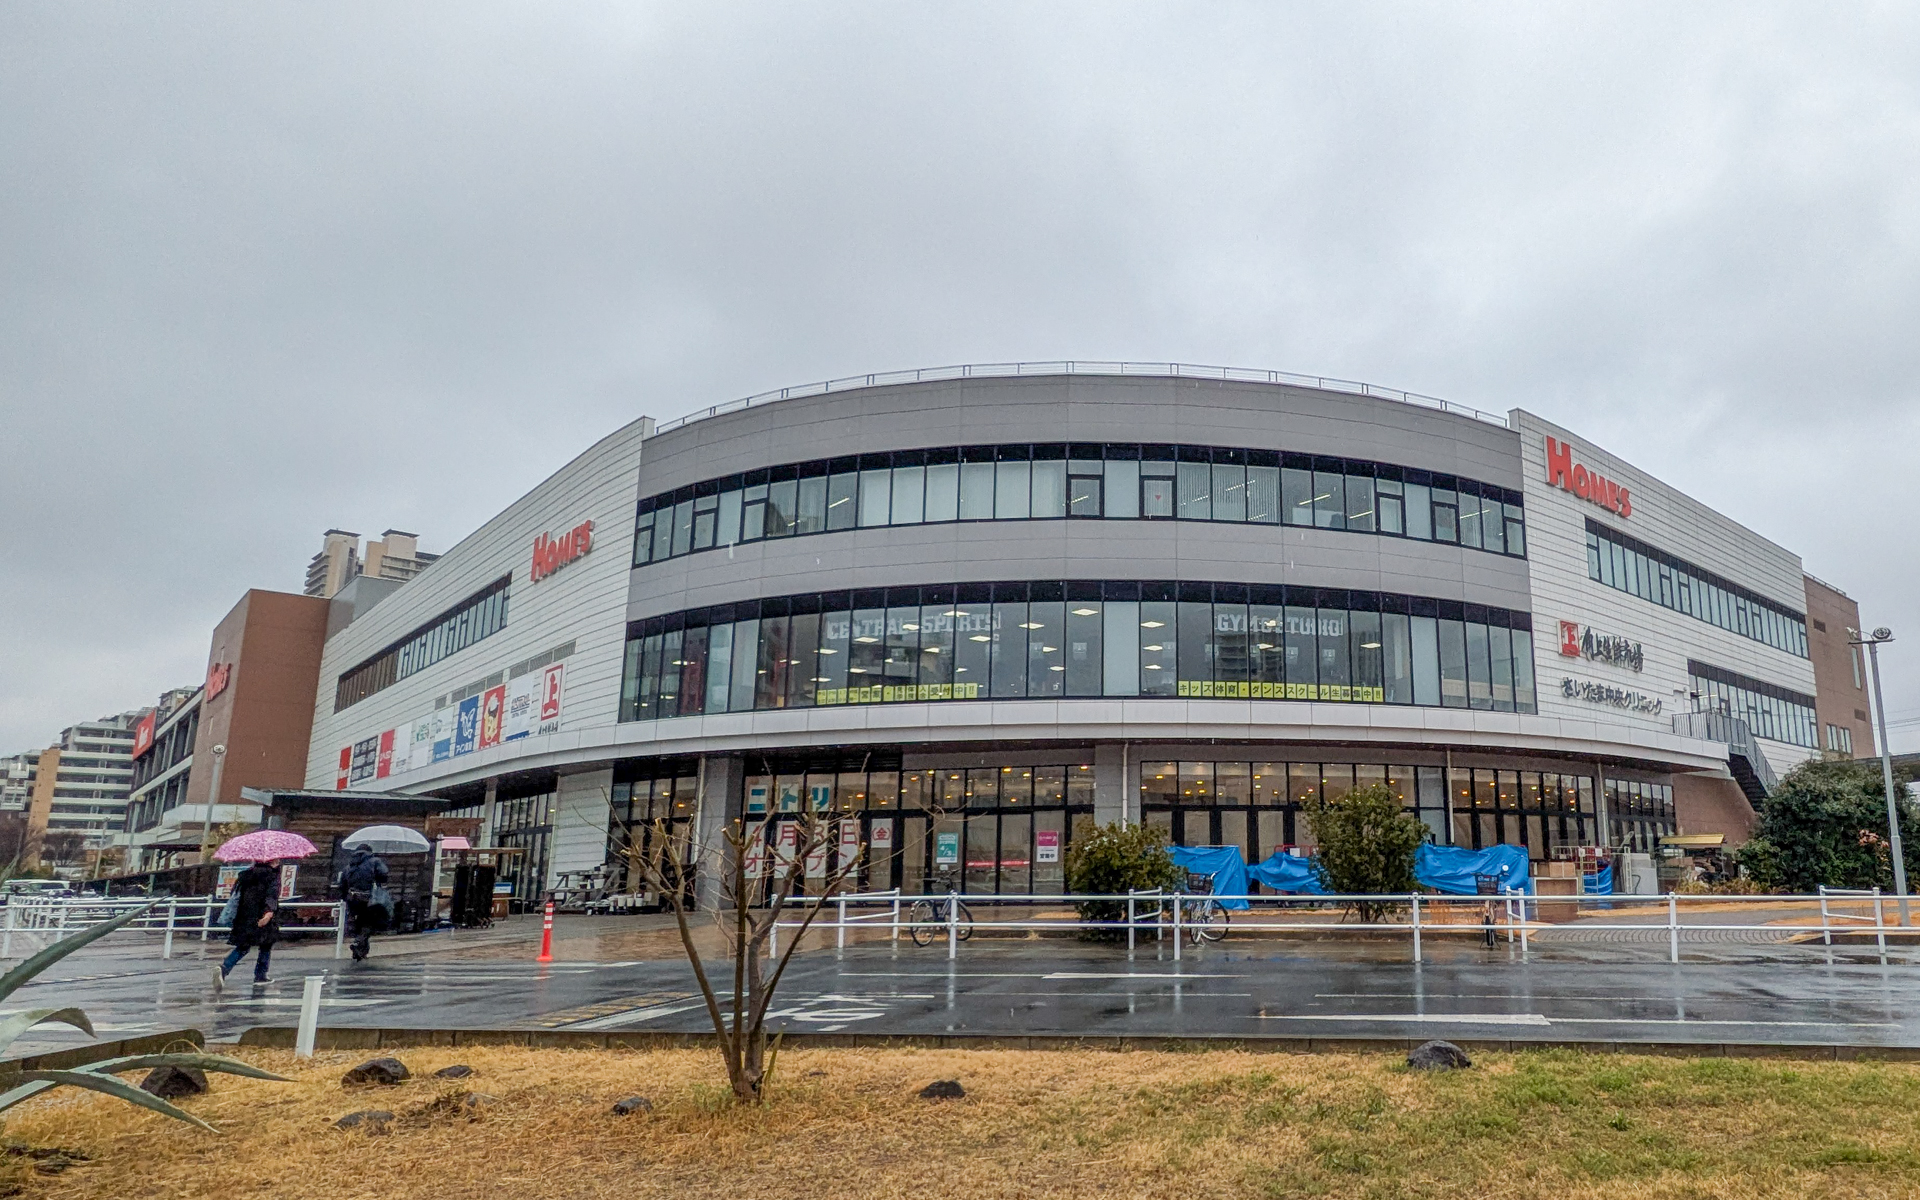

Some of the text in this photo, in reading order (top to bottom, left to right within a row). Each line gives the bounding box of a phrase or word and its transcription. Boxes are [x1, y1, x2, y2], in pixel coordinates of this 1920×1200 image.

[1545, 435, 1632, 518] HOME'S
[531, 519, 595, 582] HOME'S
[748, 786, 830, 812] ニトリ
